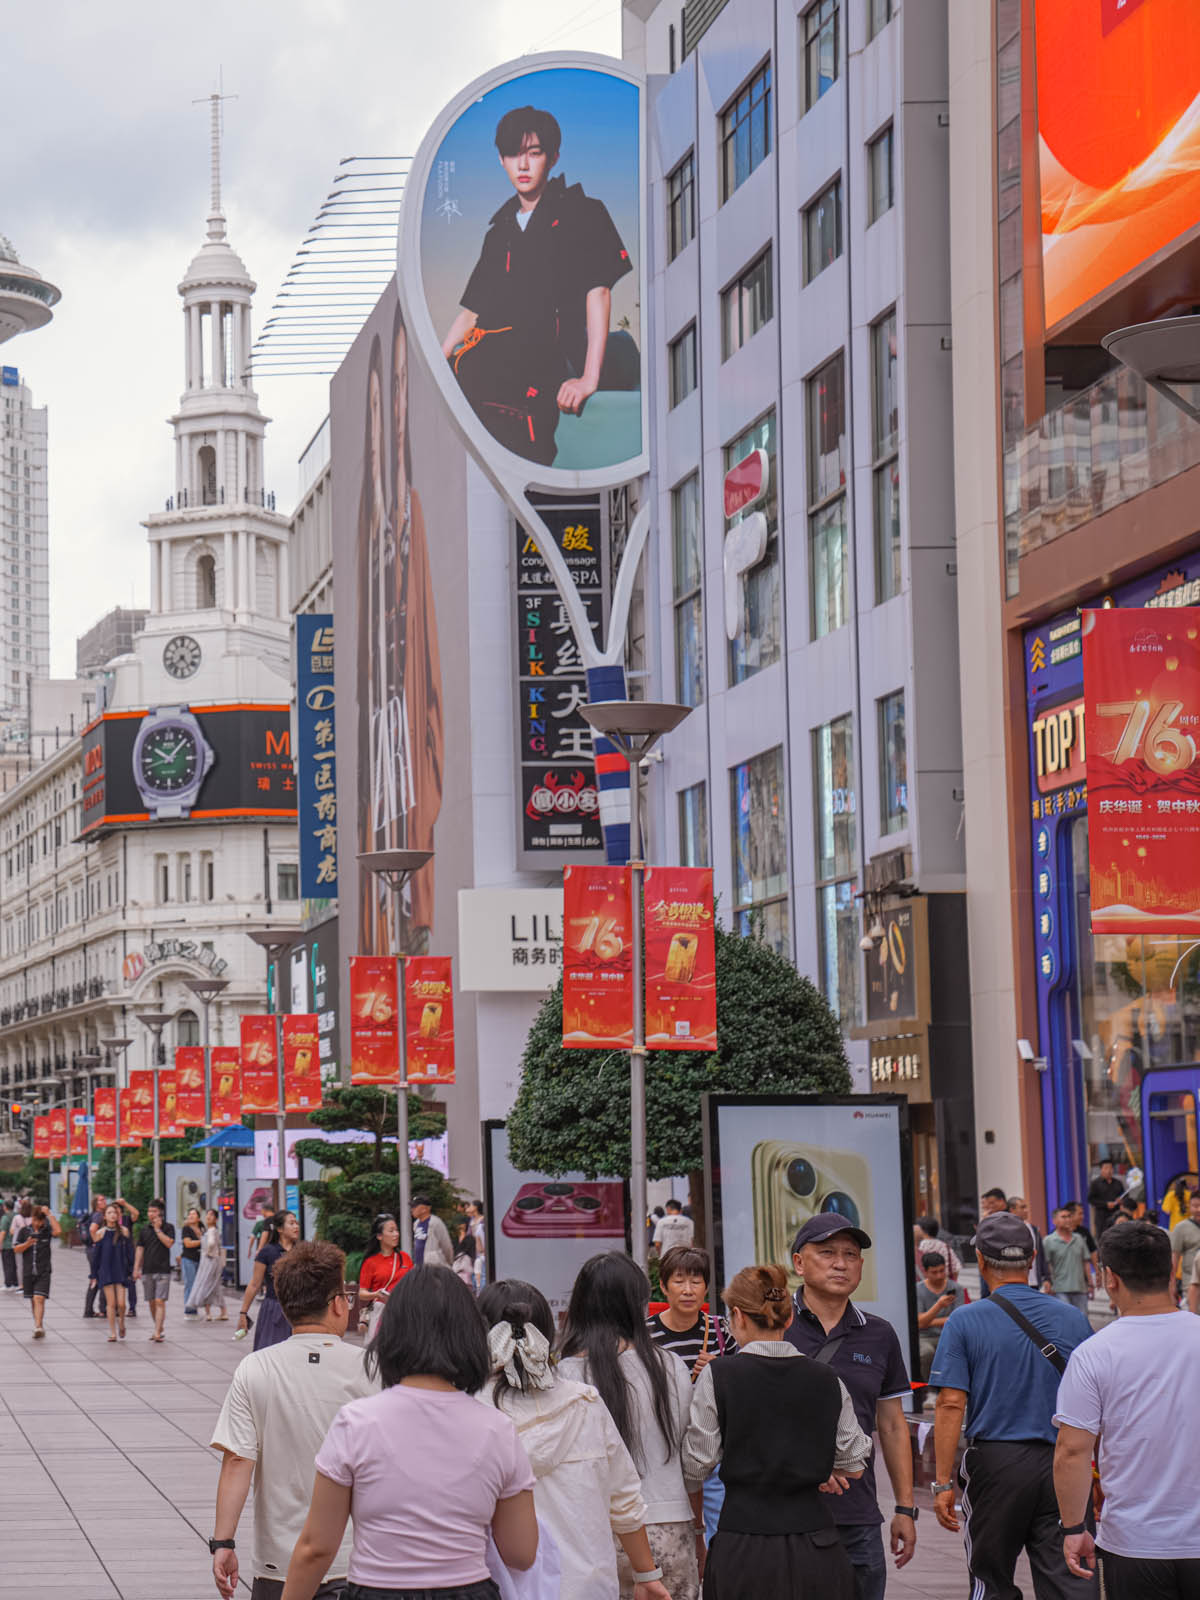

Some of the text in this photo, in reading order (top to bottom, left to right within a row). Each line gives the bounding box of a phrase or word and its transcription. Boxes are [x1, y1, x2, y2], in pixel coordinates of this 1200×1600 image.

[572, 570, 600, 585] SPA
[525, 597, 542, 609] 3F
[527, 611, 547, 752] SILK KING
[1032, 709, 1072, 778] TOP
[1095, 700, 1197, 776] 76
[250, 762, 277, 770] SWISS
[313, 717, 338, 885] 第一医药商店
[511, 914, 564, 942] LIL
[569, 916, 624, 960] 76
[354, 991, 393, 1022] 76
[244, 1041, 273, 1065] 76
[852, 1352, 872, 1365] FILA
